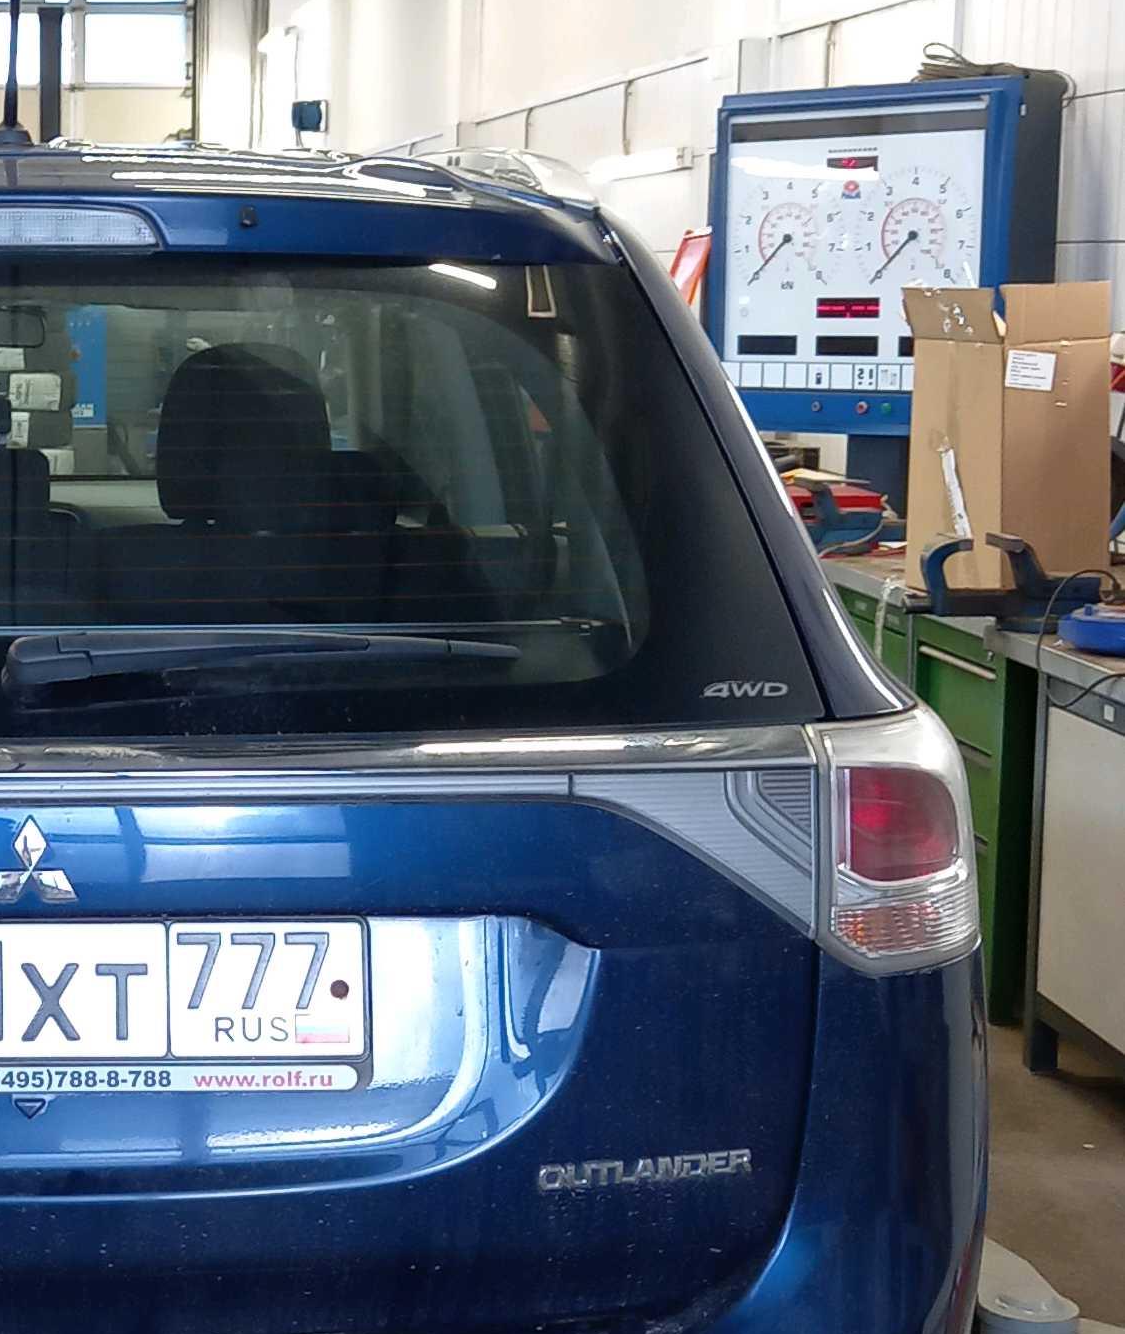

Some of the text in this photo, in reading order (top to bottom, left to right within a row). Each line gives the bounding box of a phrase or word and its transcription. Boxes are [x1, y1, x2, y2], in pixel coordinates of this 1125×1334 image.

[703, 680, 788, 698] 4WD
[176, 931, 330, 1010] 777
[214, 1016, 289, 1042] RUS
[193, 1069, 334, 1089] www.rolf.ru
[538, 1148, 752, 1191] OUTLANDER
